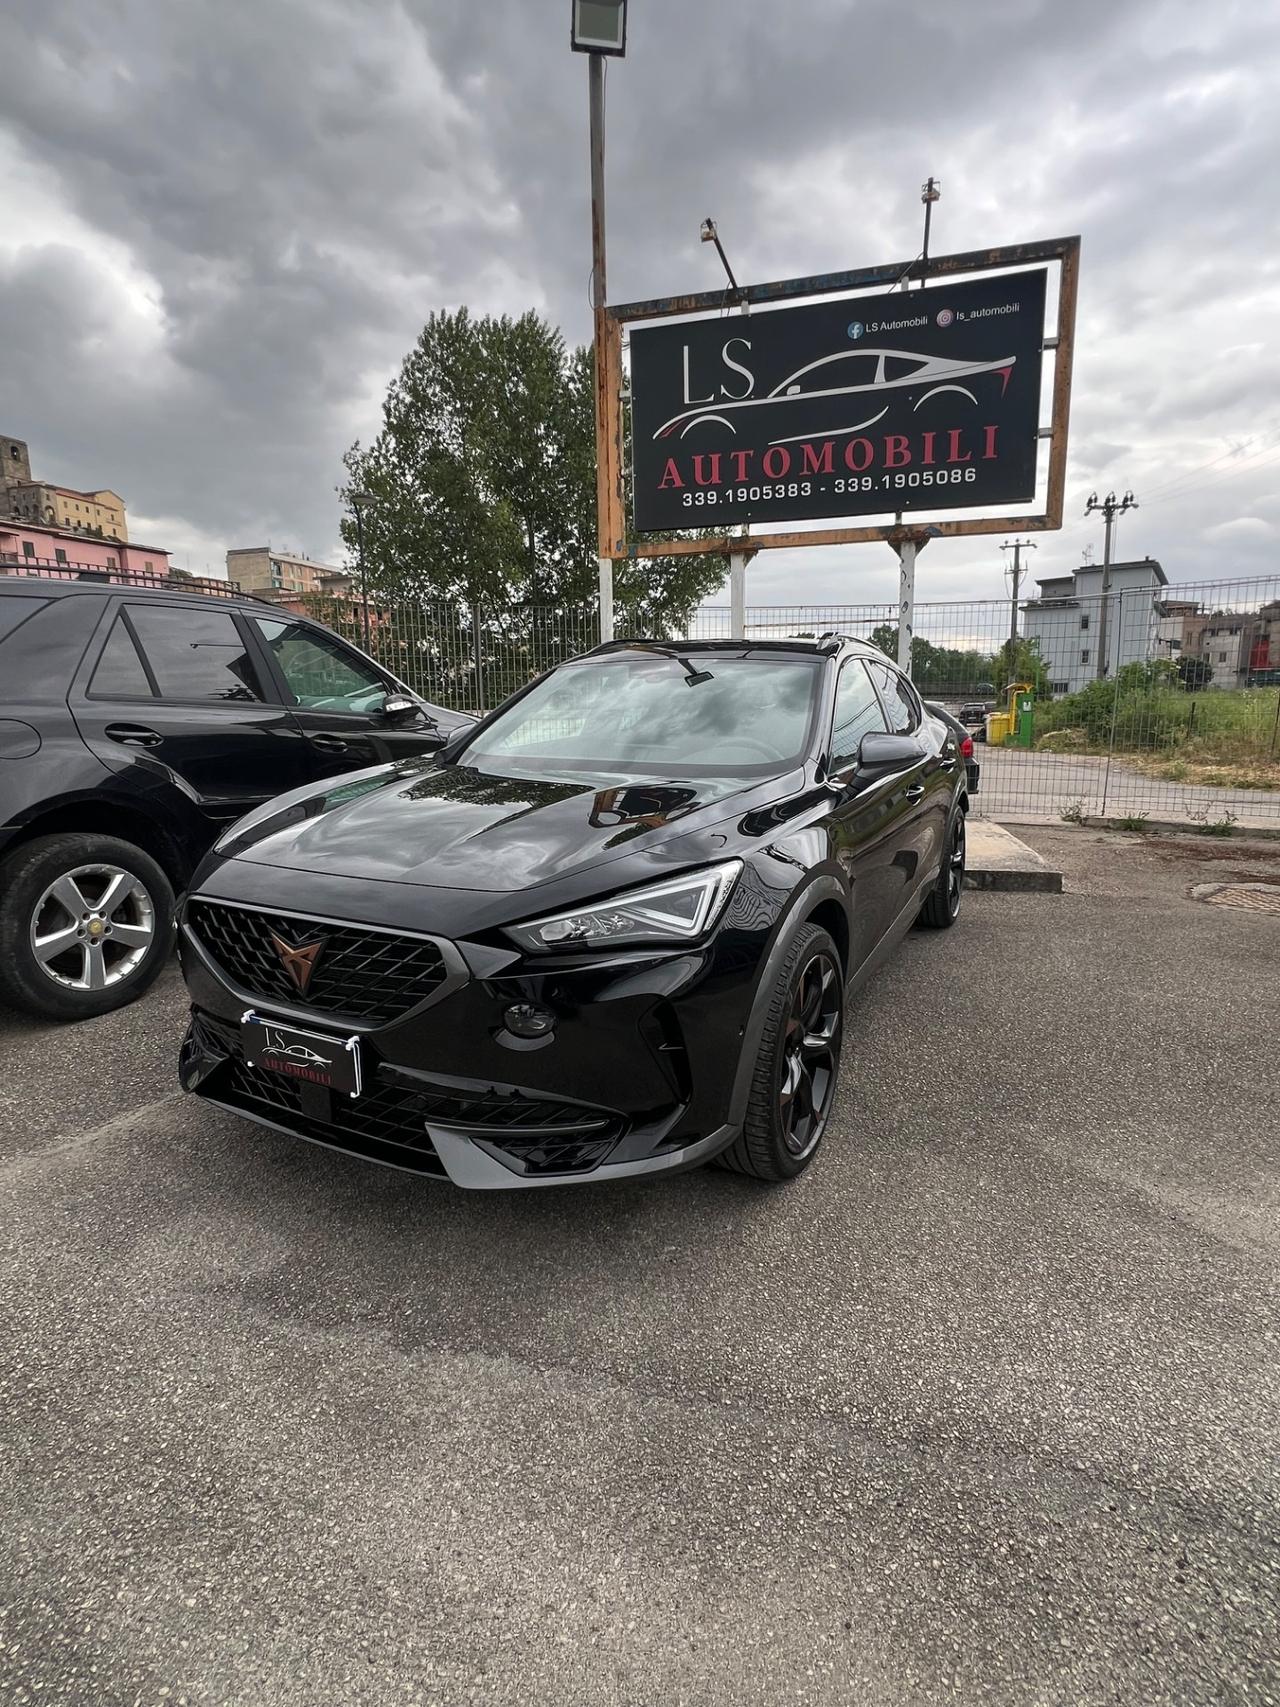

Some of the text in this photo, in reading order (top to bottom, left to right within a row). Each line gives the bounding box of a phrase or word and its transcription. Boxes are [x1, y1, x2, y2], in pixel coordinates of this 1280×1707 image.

[866, 315, 928, 333] LS Automobili
[658, 426, 999, 489] AUTOMOBILI
[682, 482, 812, 507] 339.1905383
[834, 467, 977, 494] 339.1905086
[264, 1058, 332, 1085] AUTOMOBILI
